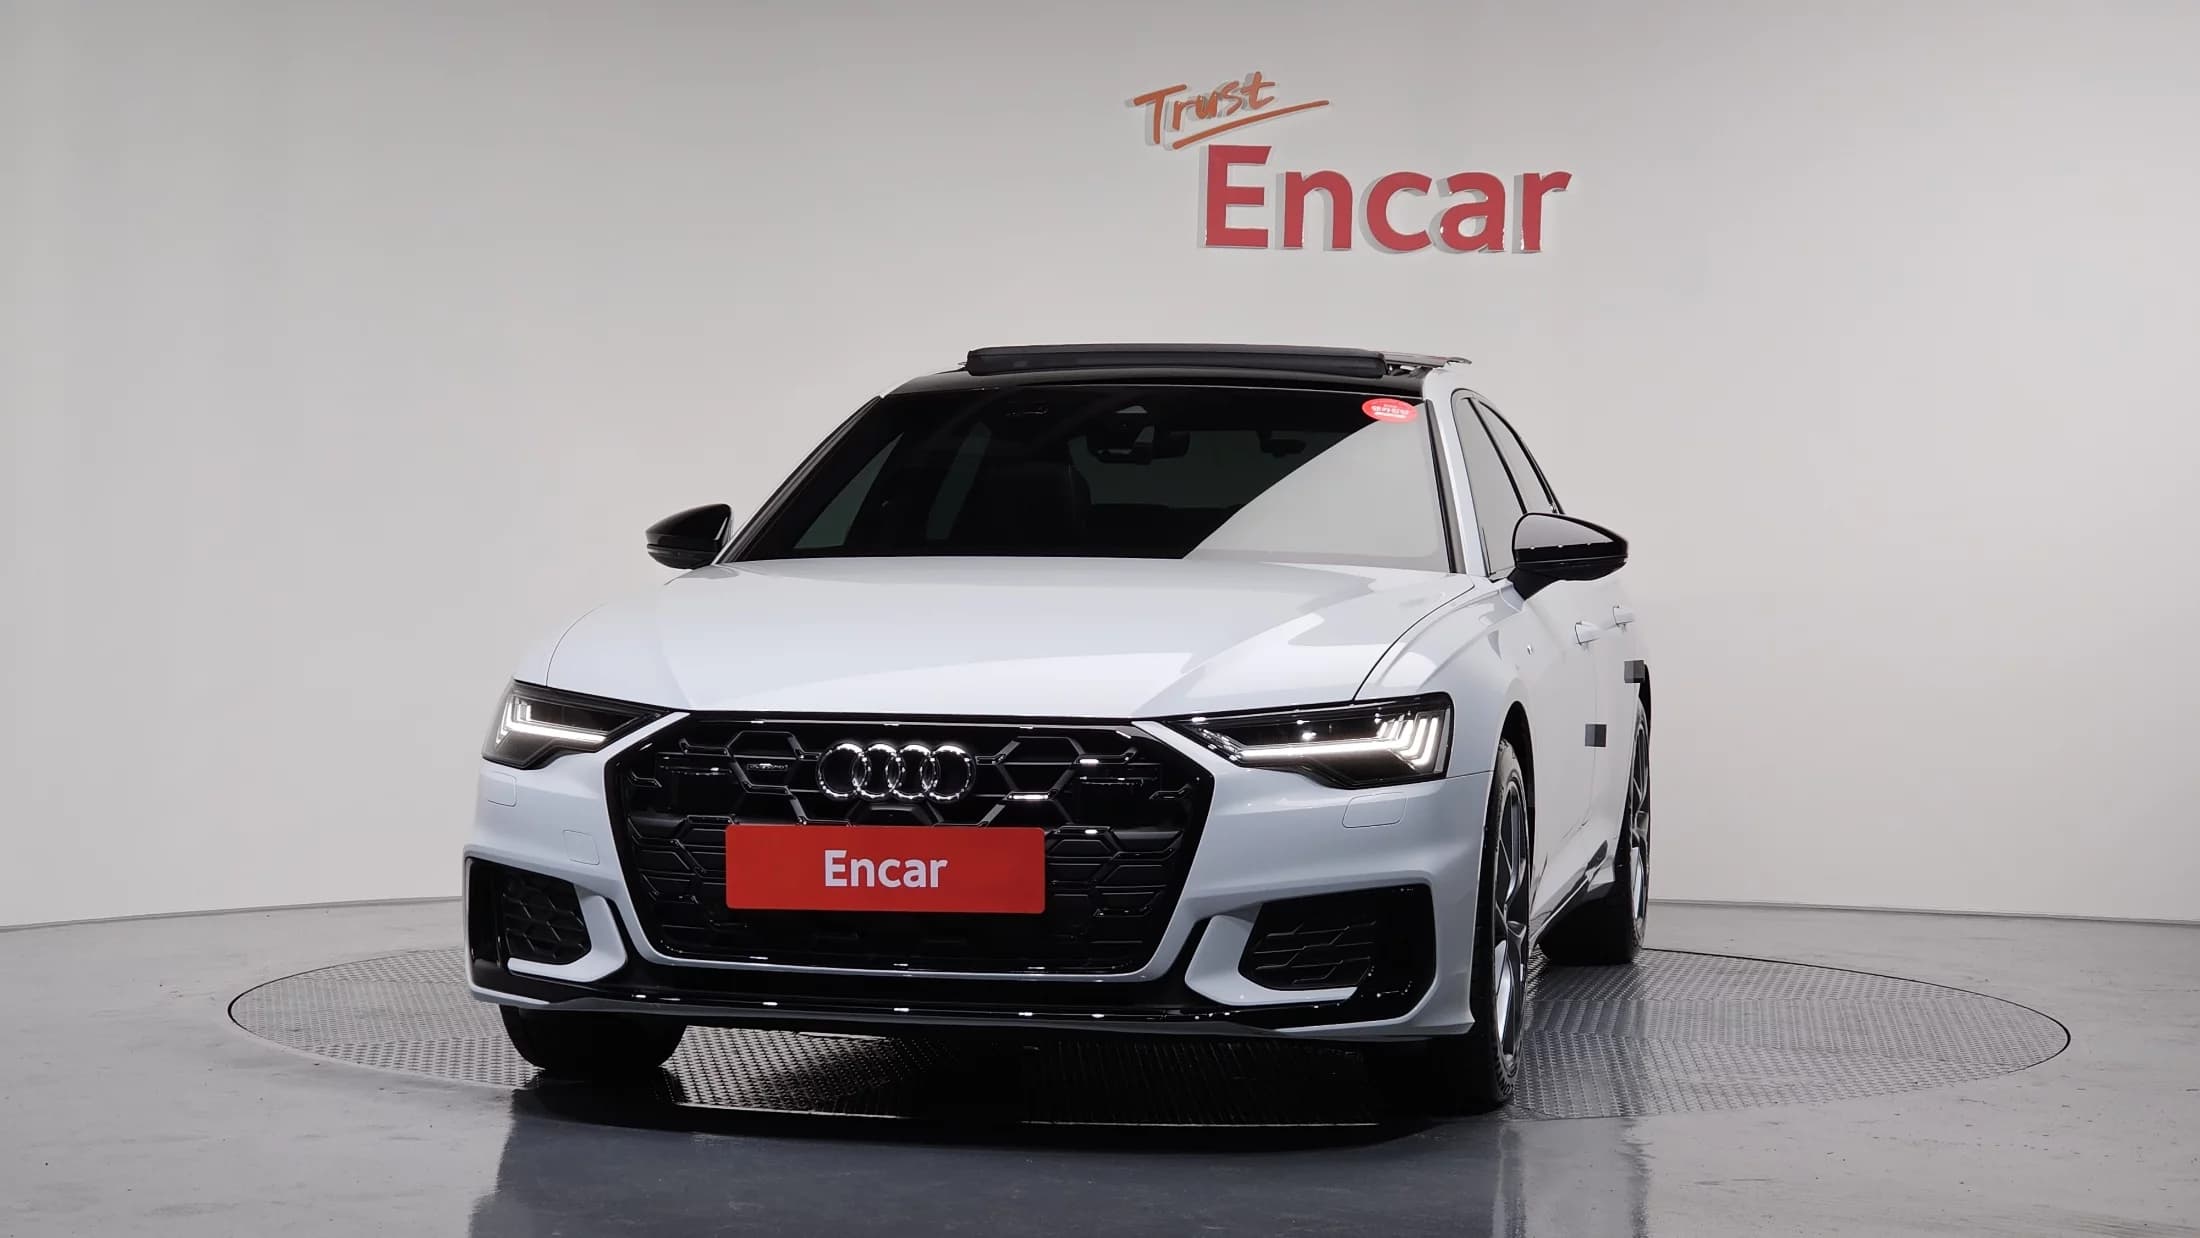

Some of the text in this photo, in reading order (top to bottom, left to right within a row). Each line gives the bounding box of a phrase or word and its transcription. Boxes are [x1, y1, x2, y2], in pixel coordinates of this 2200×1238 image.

[1134, 71, 1276, 145] Trust
[1205, 144, 1572, 252] Encar
[824, 849, 948, 888] Encar
